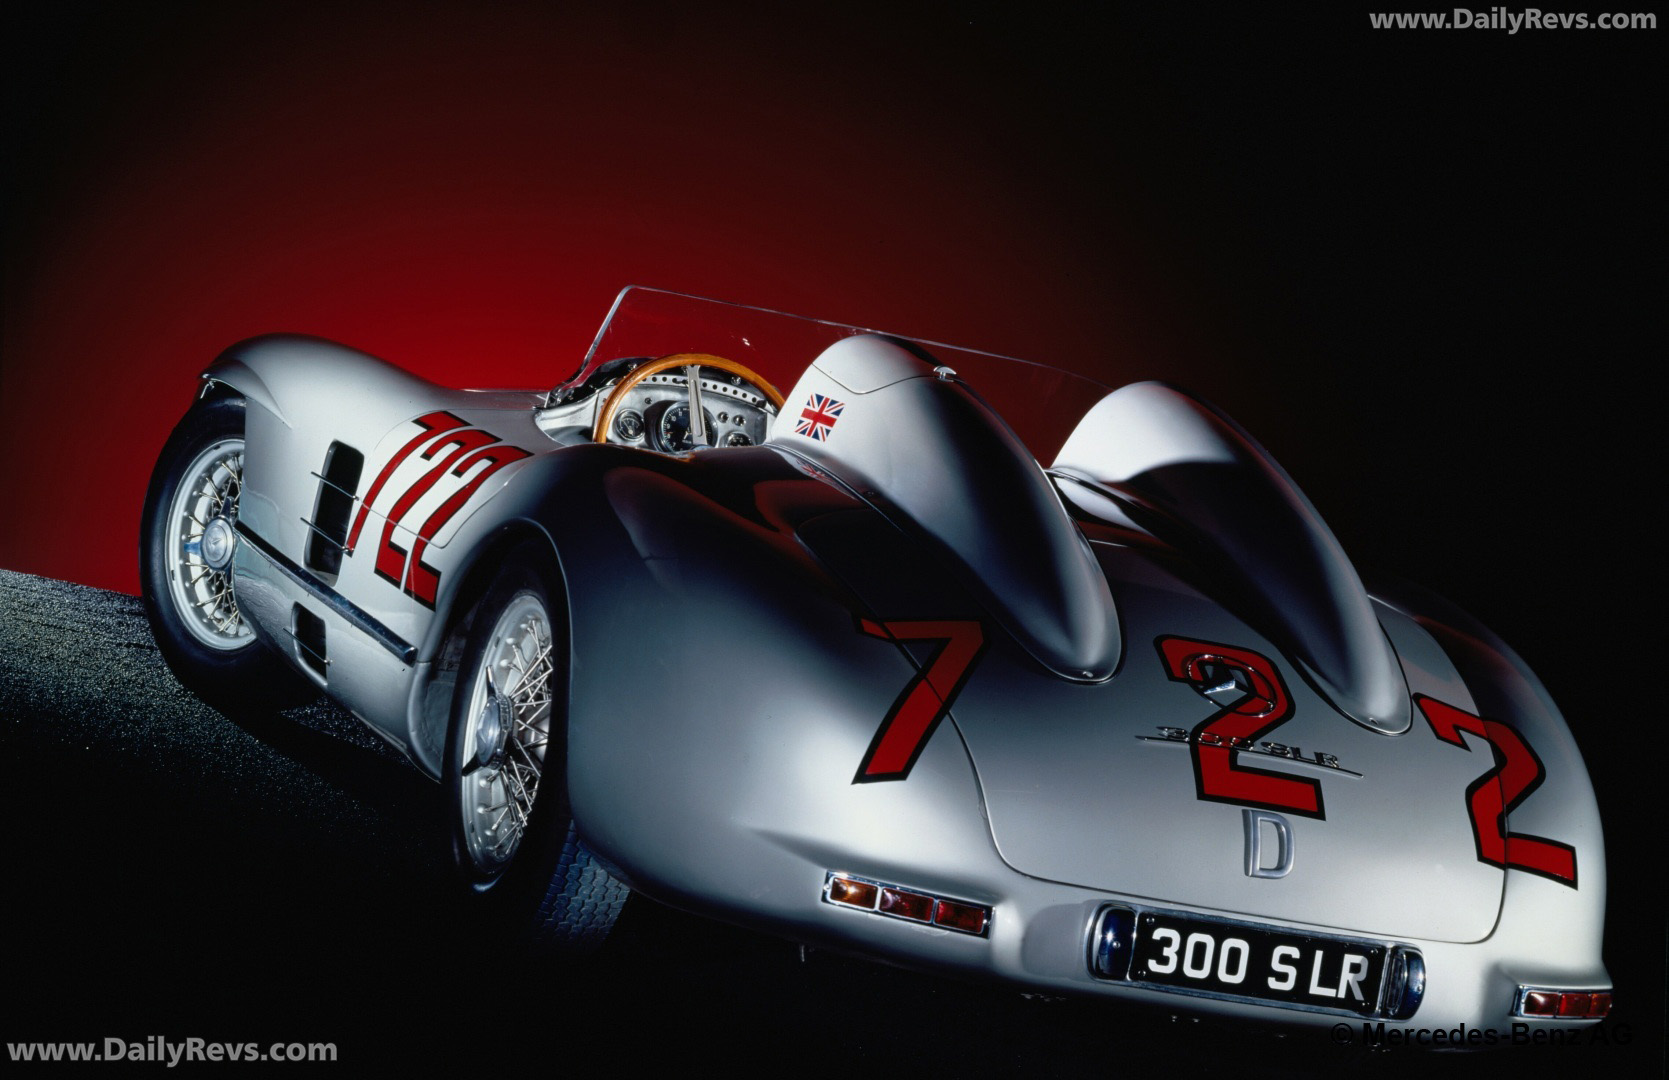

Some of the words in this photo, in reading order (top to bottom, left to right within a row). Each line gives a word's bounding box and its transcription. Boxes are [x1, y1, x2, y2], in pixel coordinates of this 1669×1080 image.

[345, 410, 535, 613] 722
[1242, 808, 1296, 880] D
[1147, 927, 1250, 985] 300
